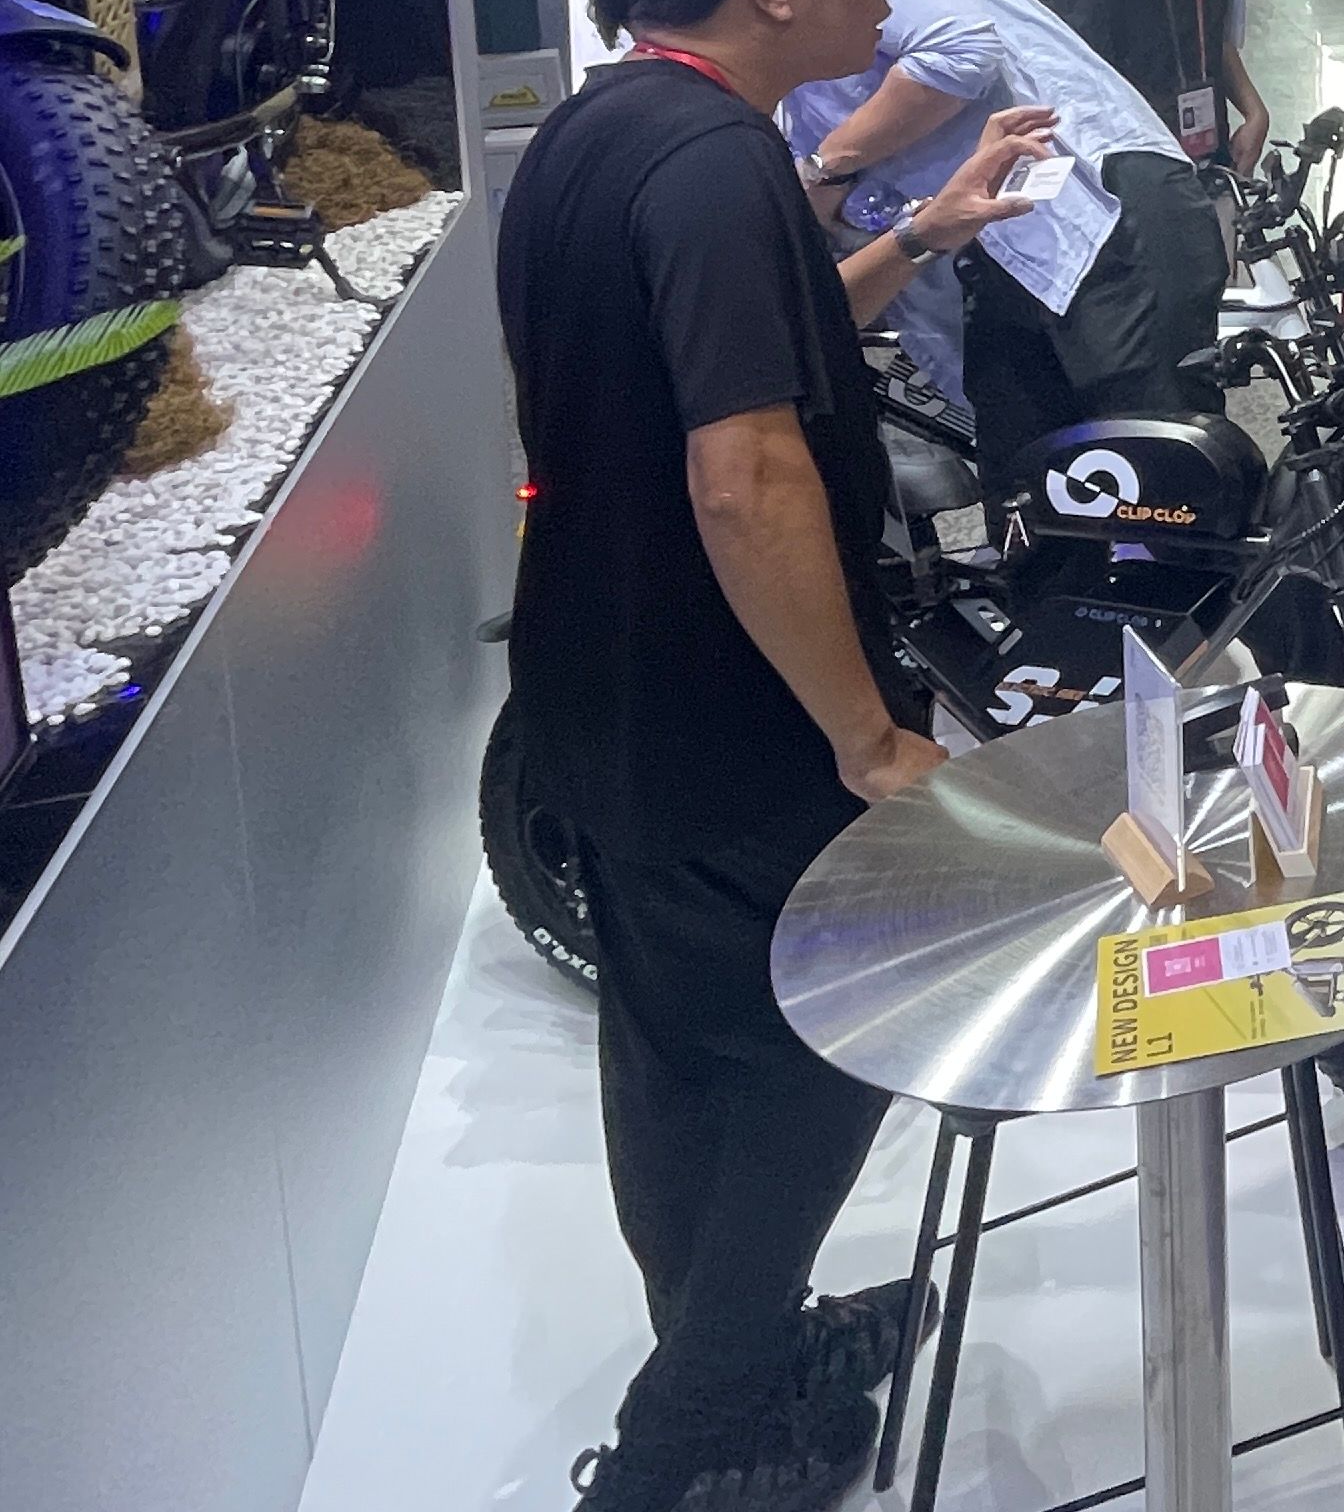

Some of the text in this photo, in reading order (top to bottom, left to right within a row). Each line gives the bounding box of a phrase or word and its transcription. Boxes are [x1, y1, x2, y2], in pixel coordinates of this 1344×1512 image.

[1116, 504, 1152, 520] CLIP
[1110, 938, 1139, 1065] NEW DESIGN
[1146, 1031, 1174, 1060] L1
